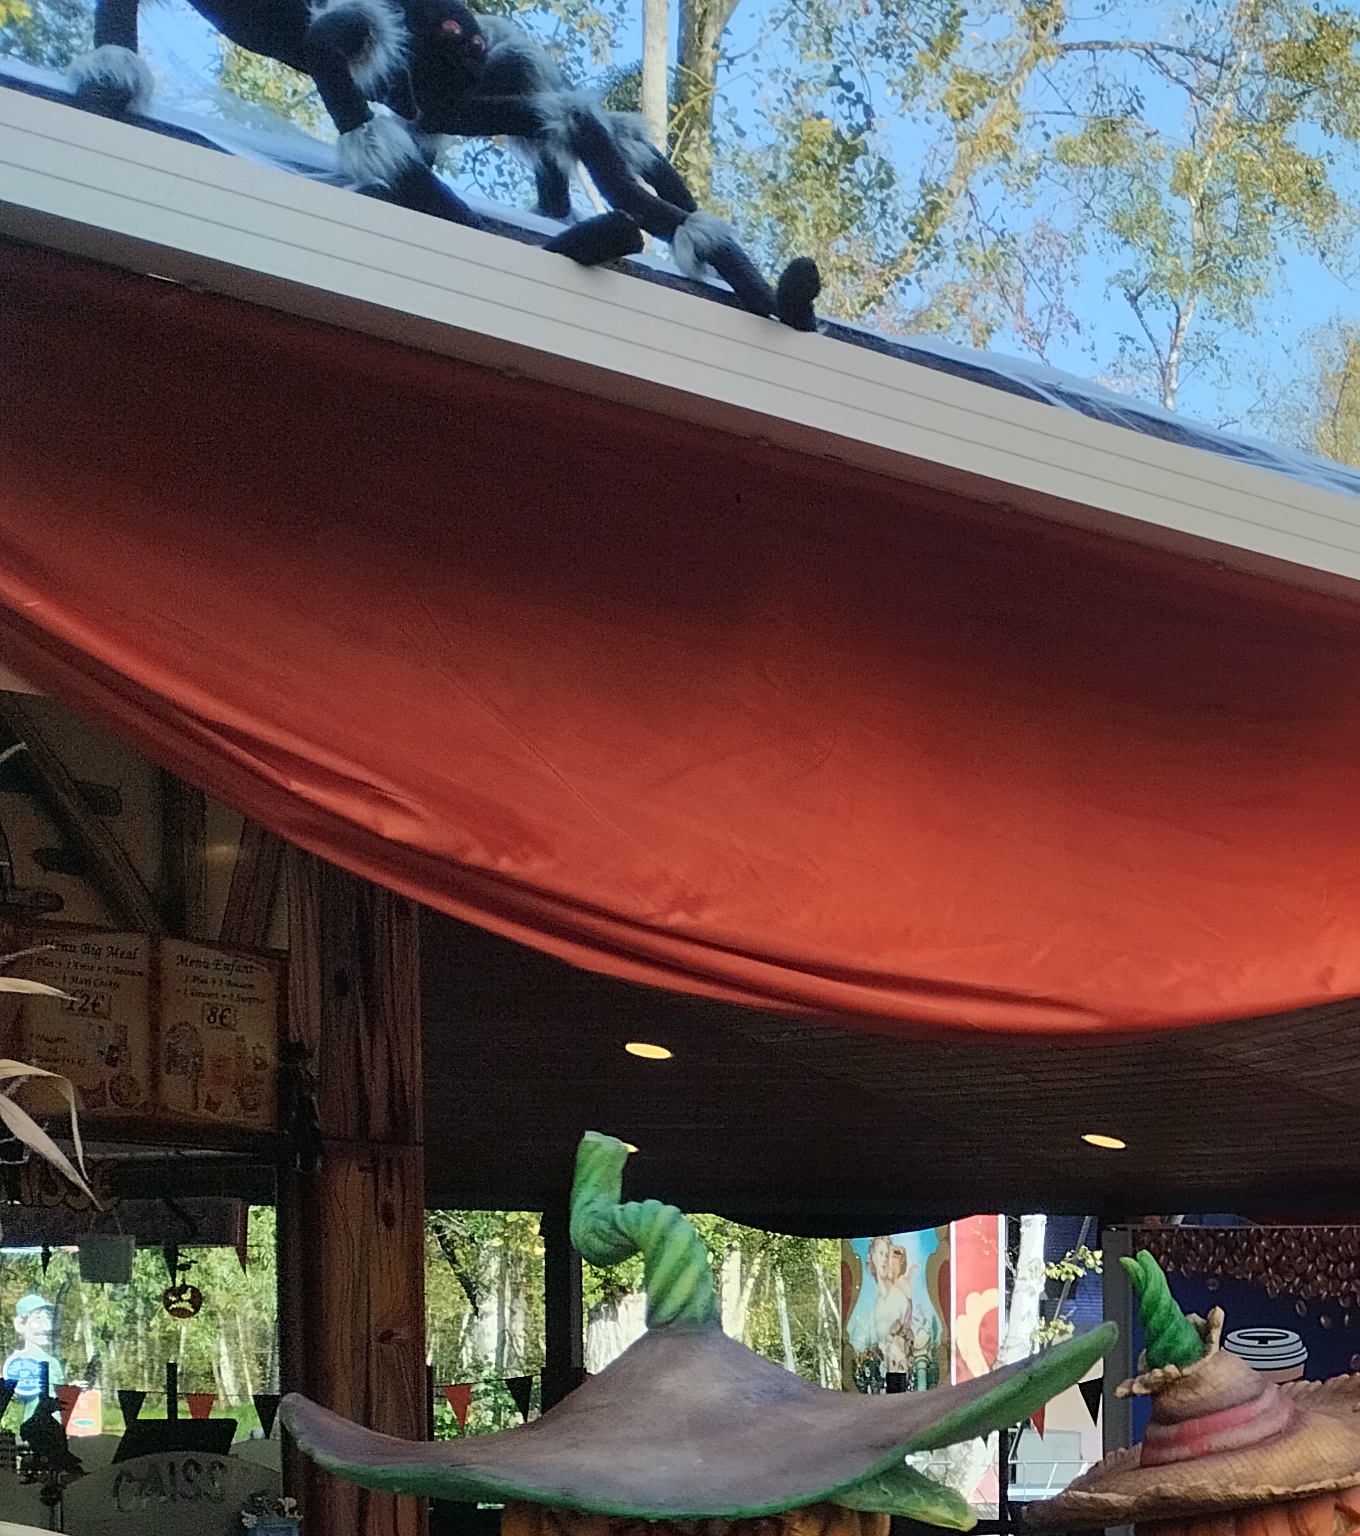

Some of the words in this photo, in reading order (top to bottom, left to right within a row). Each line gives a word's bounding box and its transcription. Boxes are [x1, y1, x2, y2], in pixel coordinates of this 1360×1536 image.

[81, 943, 102, 960] Big
[106, 945, 139, 960] Meal
[176, 954, 210, 969] Menu
[213, 959, 254, 976] Enfant
[67, 991, 105, 1015] 12€
[207, 1006, 231, 1027] 8€
